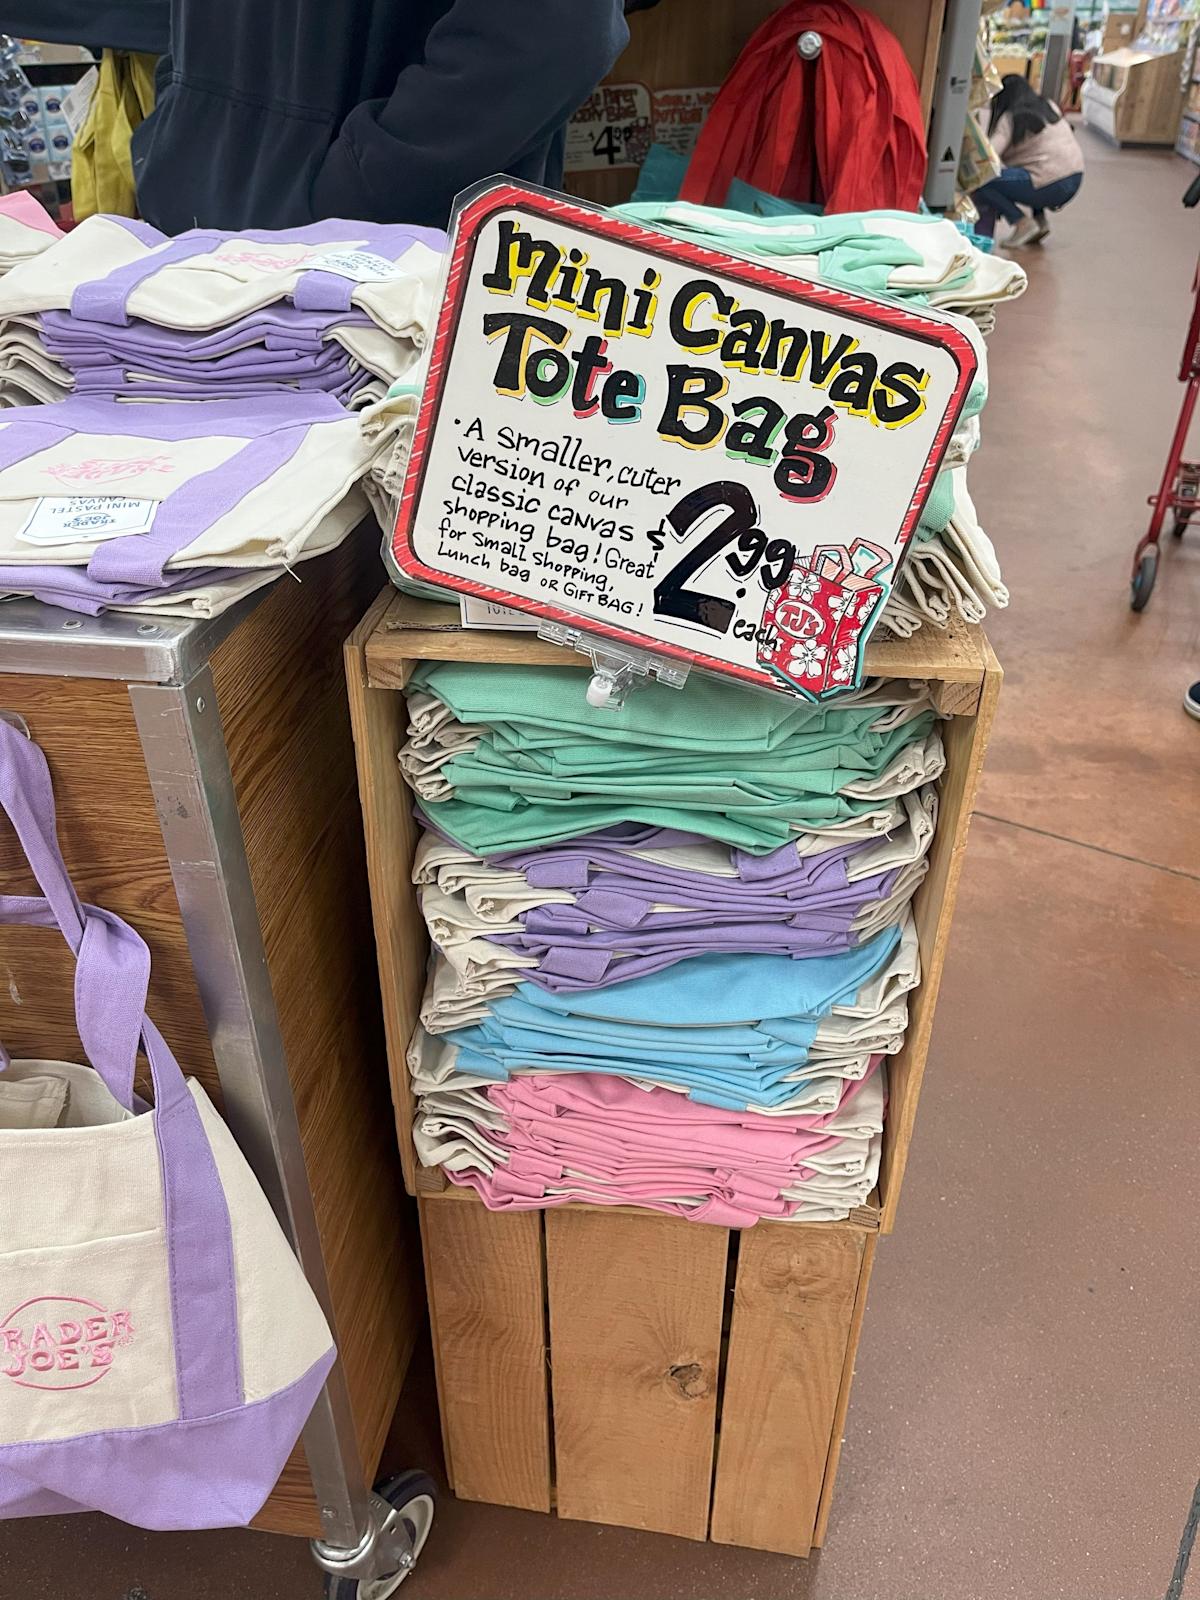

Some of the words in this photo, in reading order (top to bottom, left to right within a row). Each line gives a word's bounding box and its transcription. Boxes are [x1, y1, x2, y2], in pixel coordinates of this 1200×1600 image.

[669, 279, 931, 430] Canvas
[483, 312, 647, 425] Tote
[659, 364, 839, 504] Bag
[457, 446, 545, 488] version
[553, 478, 580, 496] of
[588, 490, 629, 510] our
[617, 466, 682, 496] cuter
[49, 503, 102, 514] PASTEL
[107, 500, 141, 510] MINI
[451, 473, 541, 513] classic
[548, 504, 635, 542] canvas
[438, 517, 467, 540] for
[443, 497, 536, 543] shopping
[546, 525, 602, 564] bag!
[605, 547, 656, 579] Great
[437, 541, 491, 570] Lunch
[499, 557, 531, 583] bag
[732, 618, 778, 650] each
[0, 1341, 117, 1378] JOE'S
